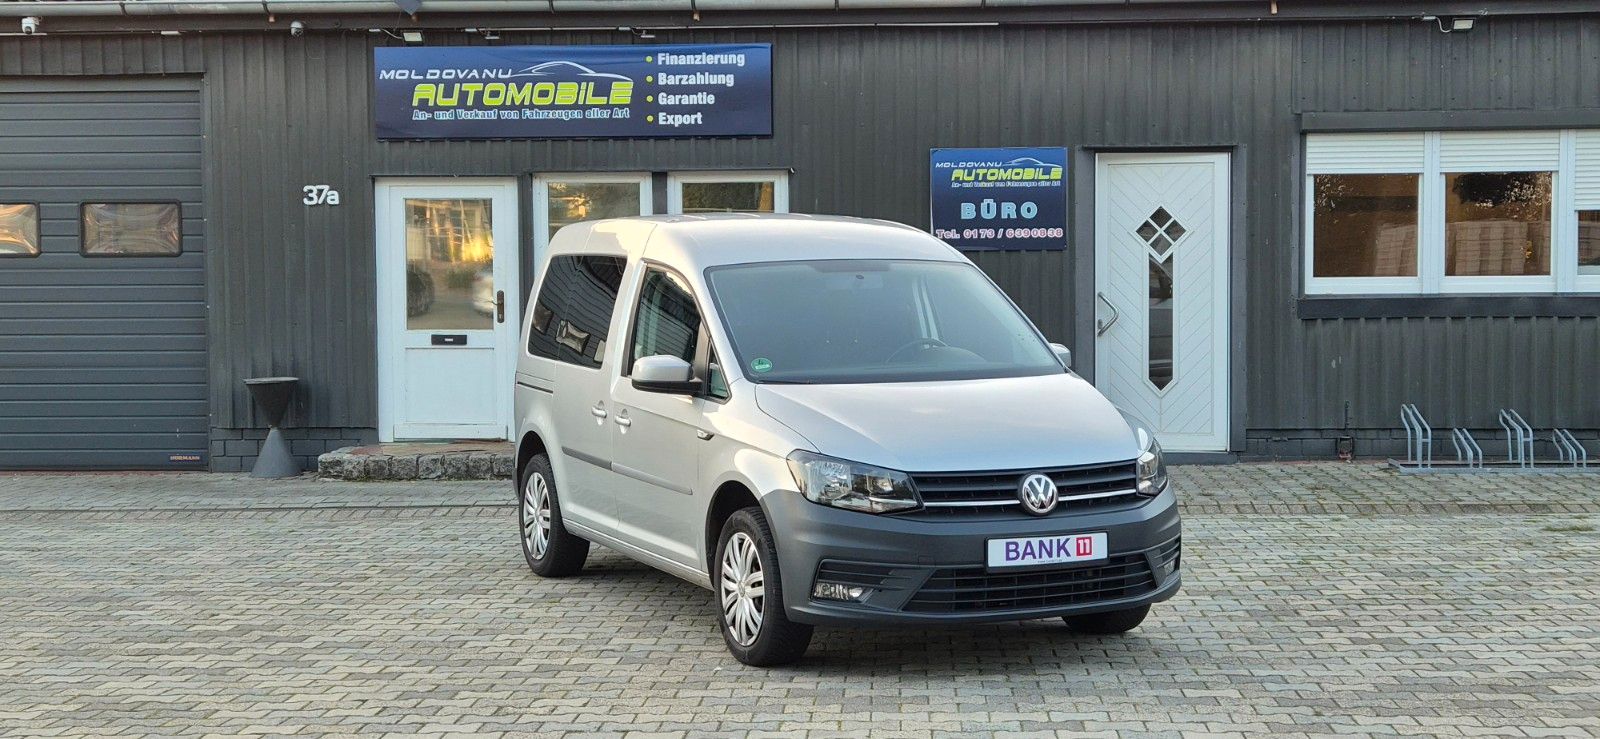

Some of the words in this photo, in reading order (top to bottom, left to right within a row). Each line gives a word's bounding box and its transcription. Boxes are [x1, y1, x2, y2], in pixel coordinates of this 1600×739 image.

[657, 52, 745, 67] Finanzierung
[380, 69, 512, 80] MOLDOVANU
[658, 72, 735, 87] Barzahlung
[658, 92, 715, 105] Garantie
[412, 109, 432, 120] An-
[434, 109, 454, 119] und
[456, 108, 498, 119] Verkauf
[500, 110, 519, 119] von
[521, 108, 583, 120] Fahrzeugen
[585, 108, 611, 119] aller
[612, 107, 630, 118] Art
[658, 112, 703, 127] Export
[302, 184, 340, 205] 37a
[960, 198, 1038, 219] BÜRO
[936, 229, 960, 239] Tel.
[963, 228, 995, 239] 0173
[1005, 227, 1064, 239] 6390838
[1005, 537, 1072, 561] BANK
[1077, 538, 1092, 555] 11
